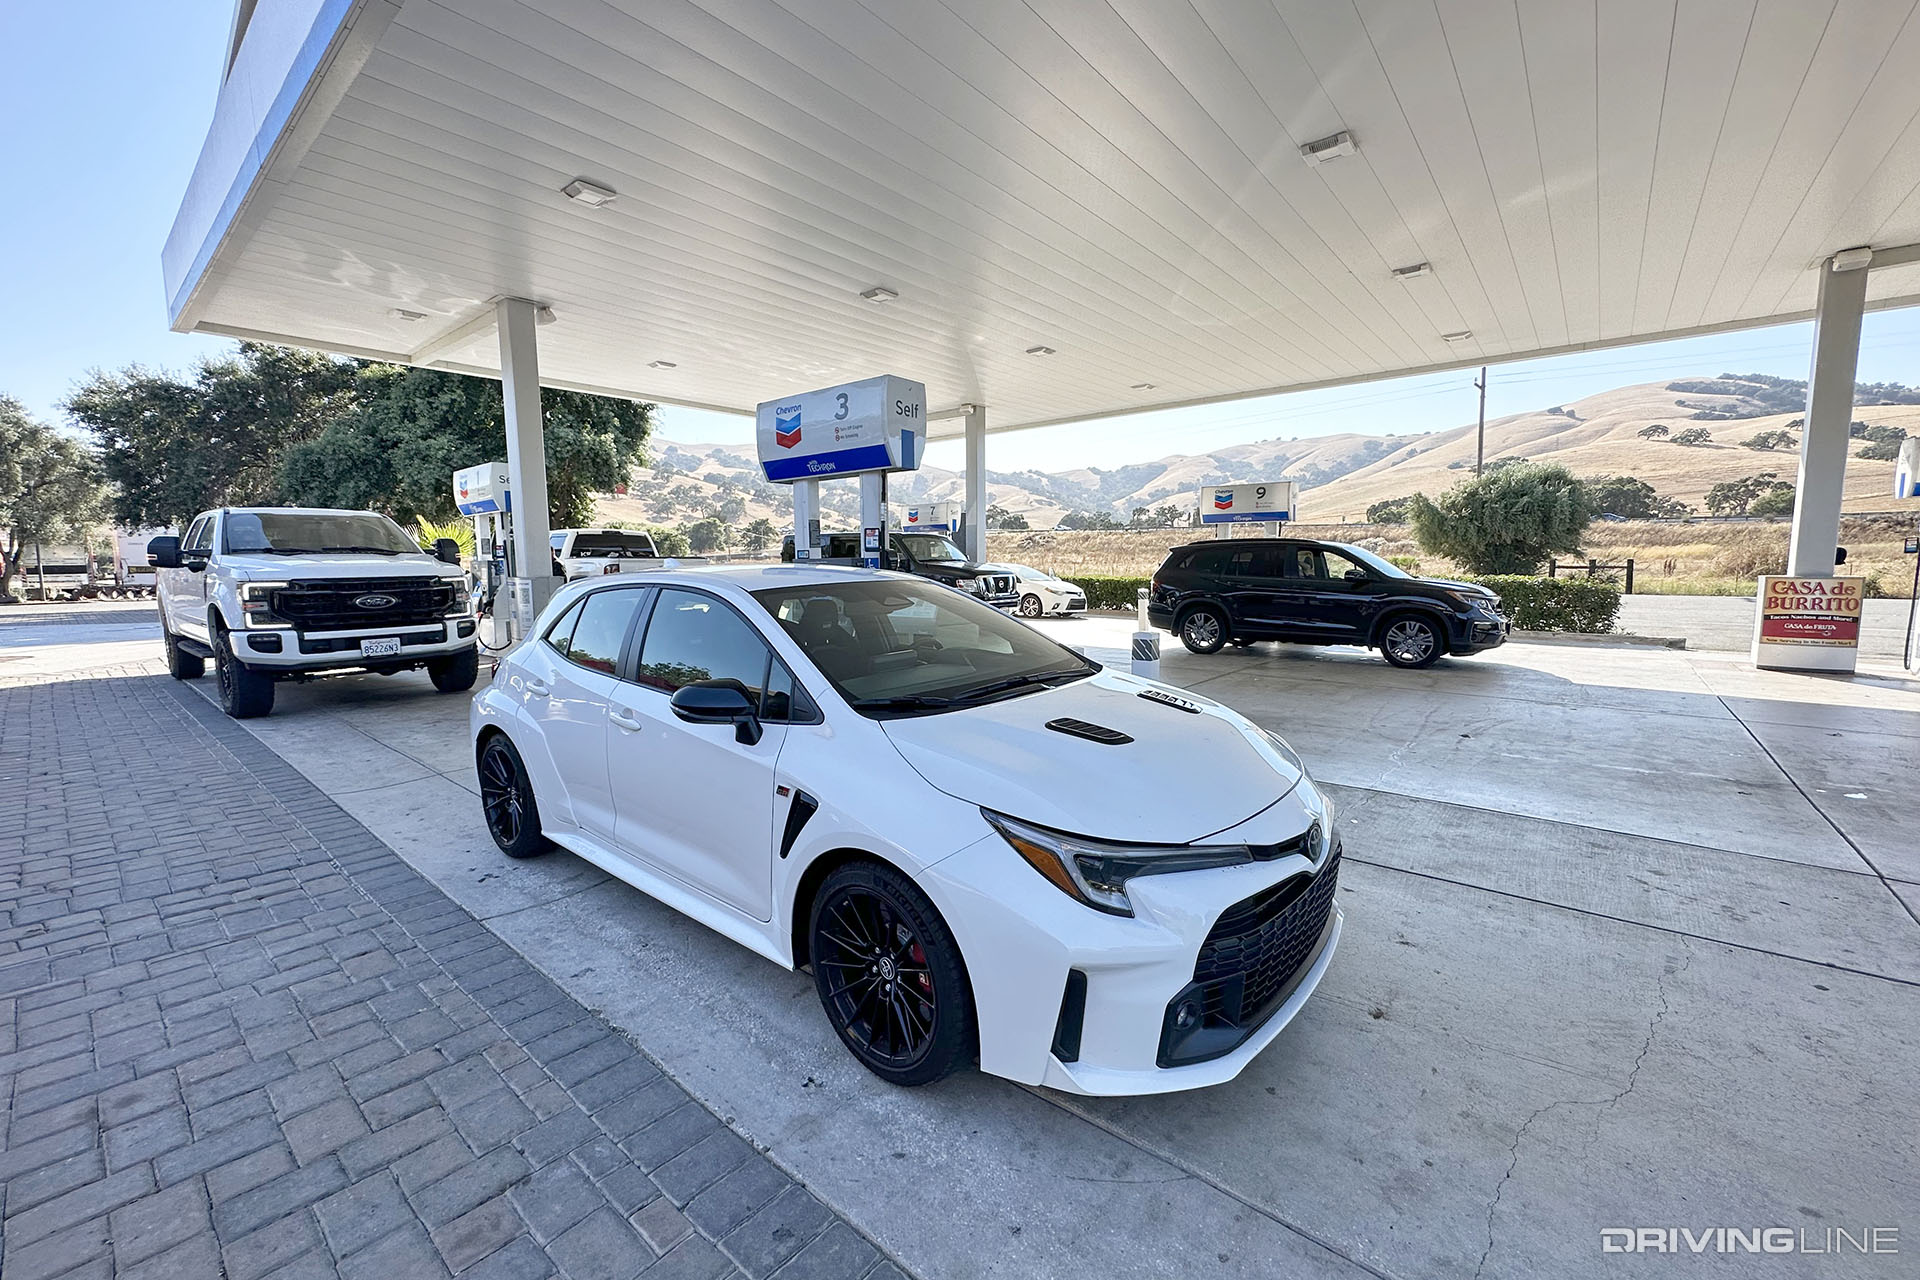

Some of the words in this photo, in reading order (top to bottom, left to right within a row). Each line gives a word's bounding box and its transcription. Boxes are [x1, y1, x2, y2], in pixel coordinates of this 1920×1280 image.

[775, 404, 802, 416] Chevron
[834, 392, 849, 420] 3
[896, 400, 919, 419] Self
[498, 474, 511, 485] Se
[1256, 486, 1267, 500] 9
[930, 506, 936, 516] 7
[1771, 580, 1827, 596] CASA
[1830, 581, 1856, 596] de
[1765, 596, 1859, 612] BURRITO
[1784, 622, 1803, 630] CASA
[1813, 623, 1837, 631] FRUTA
[364, 643, 399, 655] 85226N3
